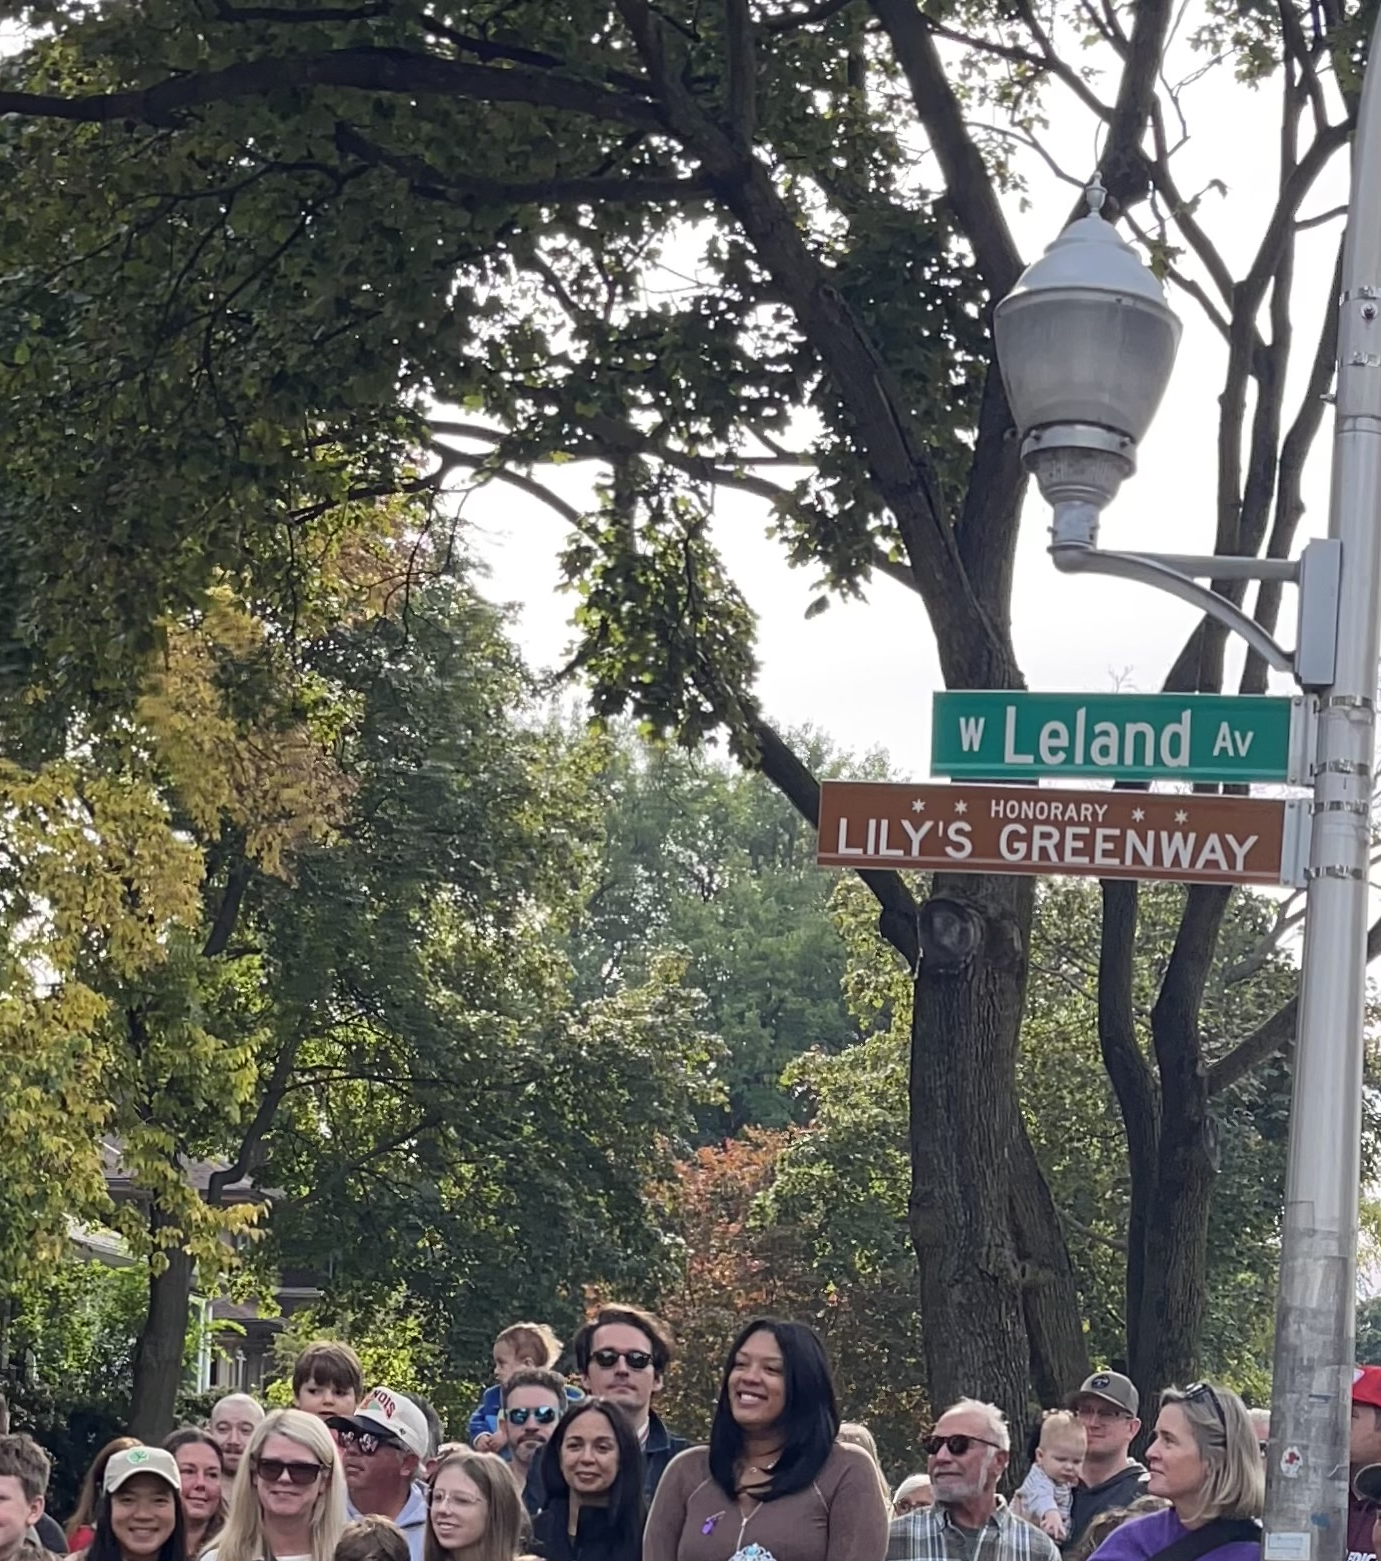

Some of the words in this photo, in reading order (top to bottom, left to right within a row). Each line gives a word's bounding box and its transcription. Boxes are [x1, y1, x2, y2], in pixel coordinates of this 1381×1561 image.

[959, 716, 985, 752] W
[1003, 705, 1192, 767] Leland
[1212, 721, 1255, 758] Av
[990, 799, 1108, 824] HONORARY
[837, 816, 973, 860] LILY'S
[999, 823, 1258, 872] GREENWAY
